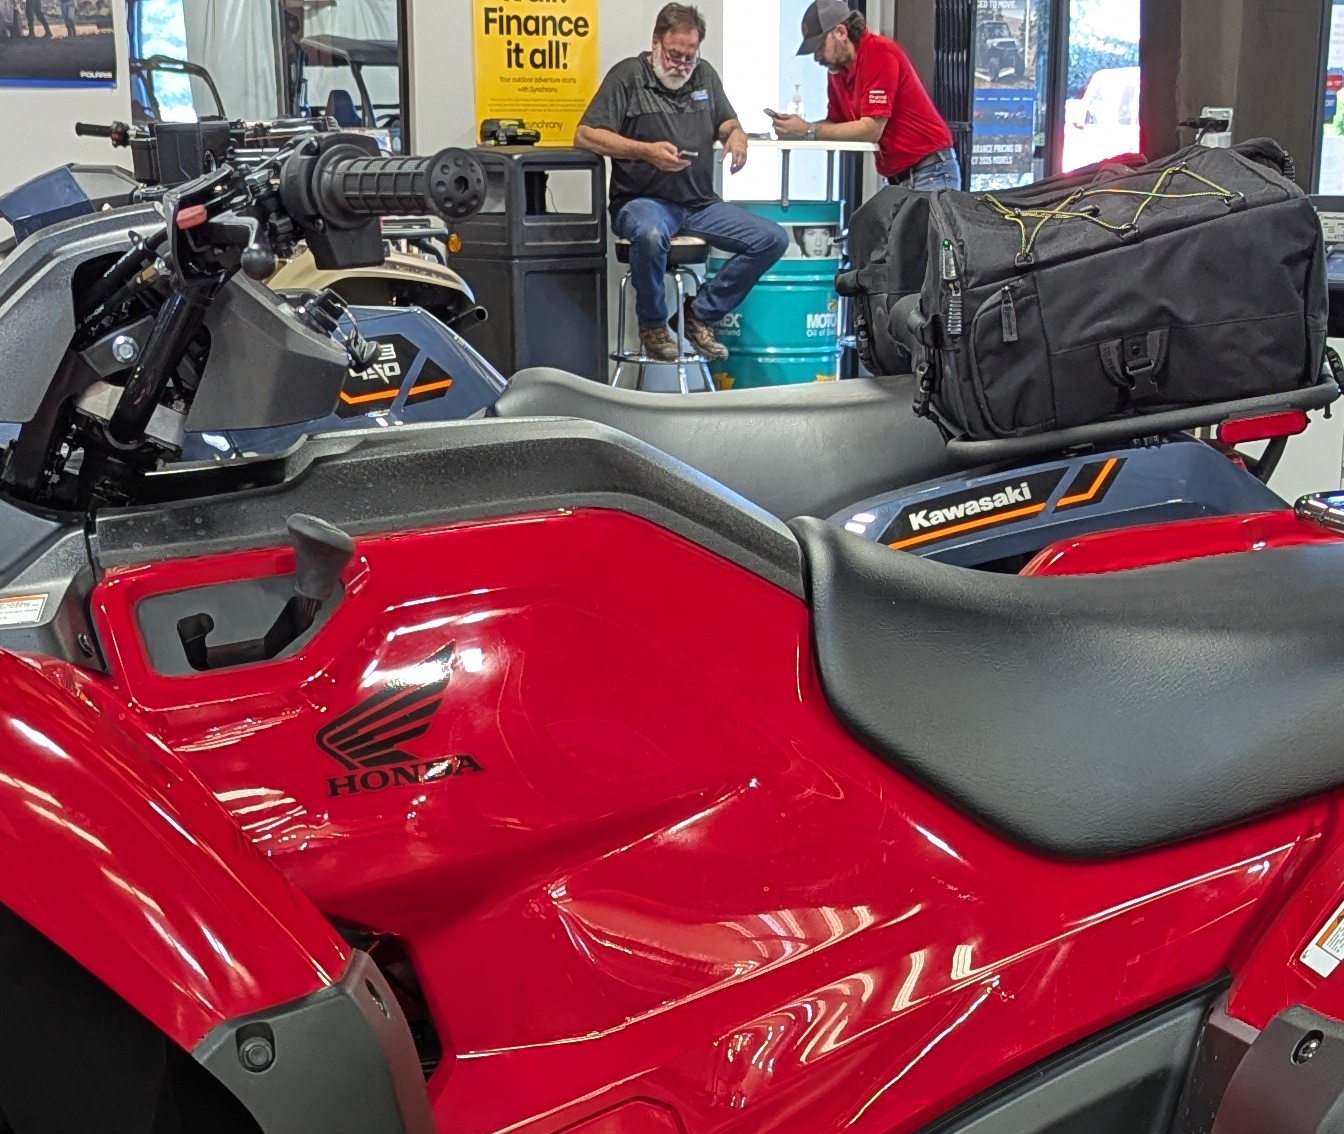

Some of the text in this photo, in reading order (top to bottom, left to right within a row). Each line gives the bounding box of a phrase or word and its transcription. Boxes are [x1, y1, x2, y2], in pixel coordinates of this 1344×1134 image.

[484, 6, 589, 37] Finance
[507, 40, 568, 70] it all!
[908, 481, 1033, 532] Kawasaki
[326, 753, 484, 799] HONDA
